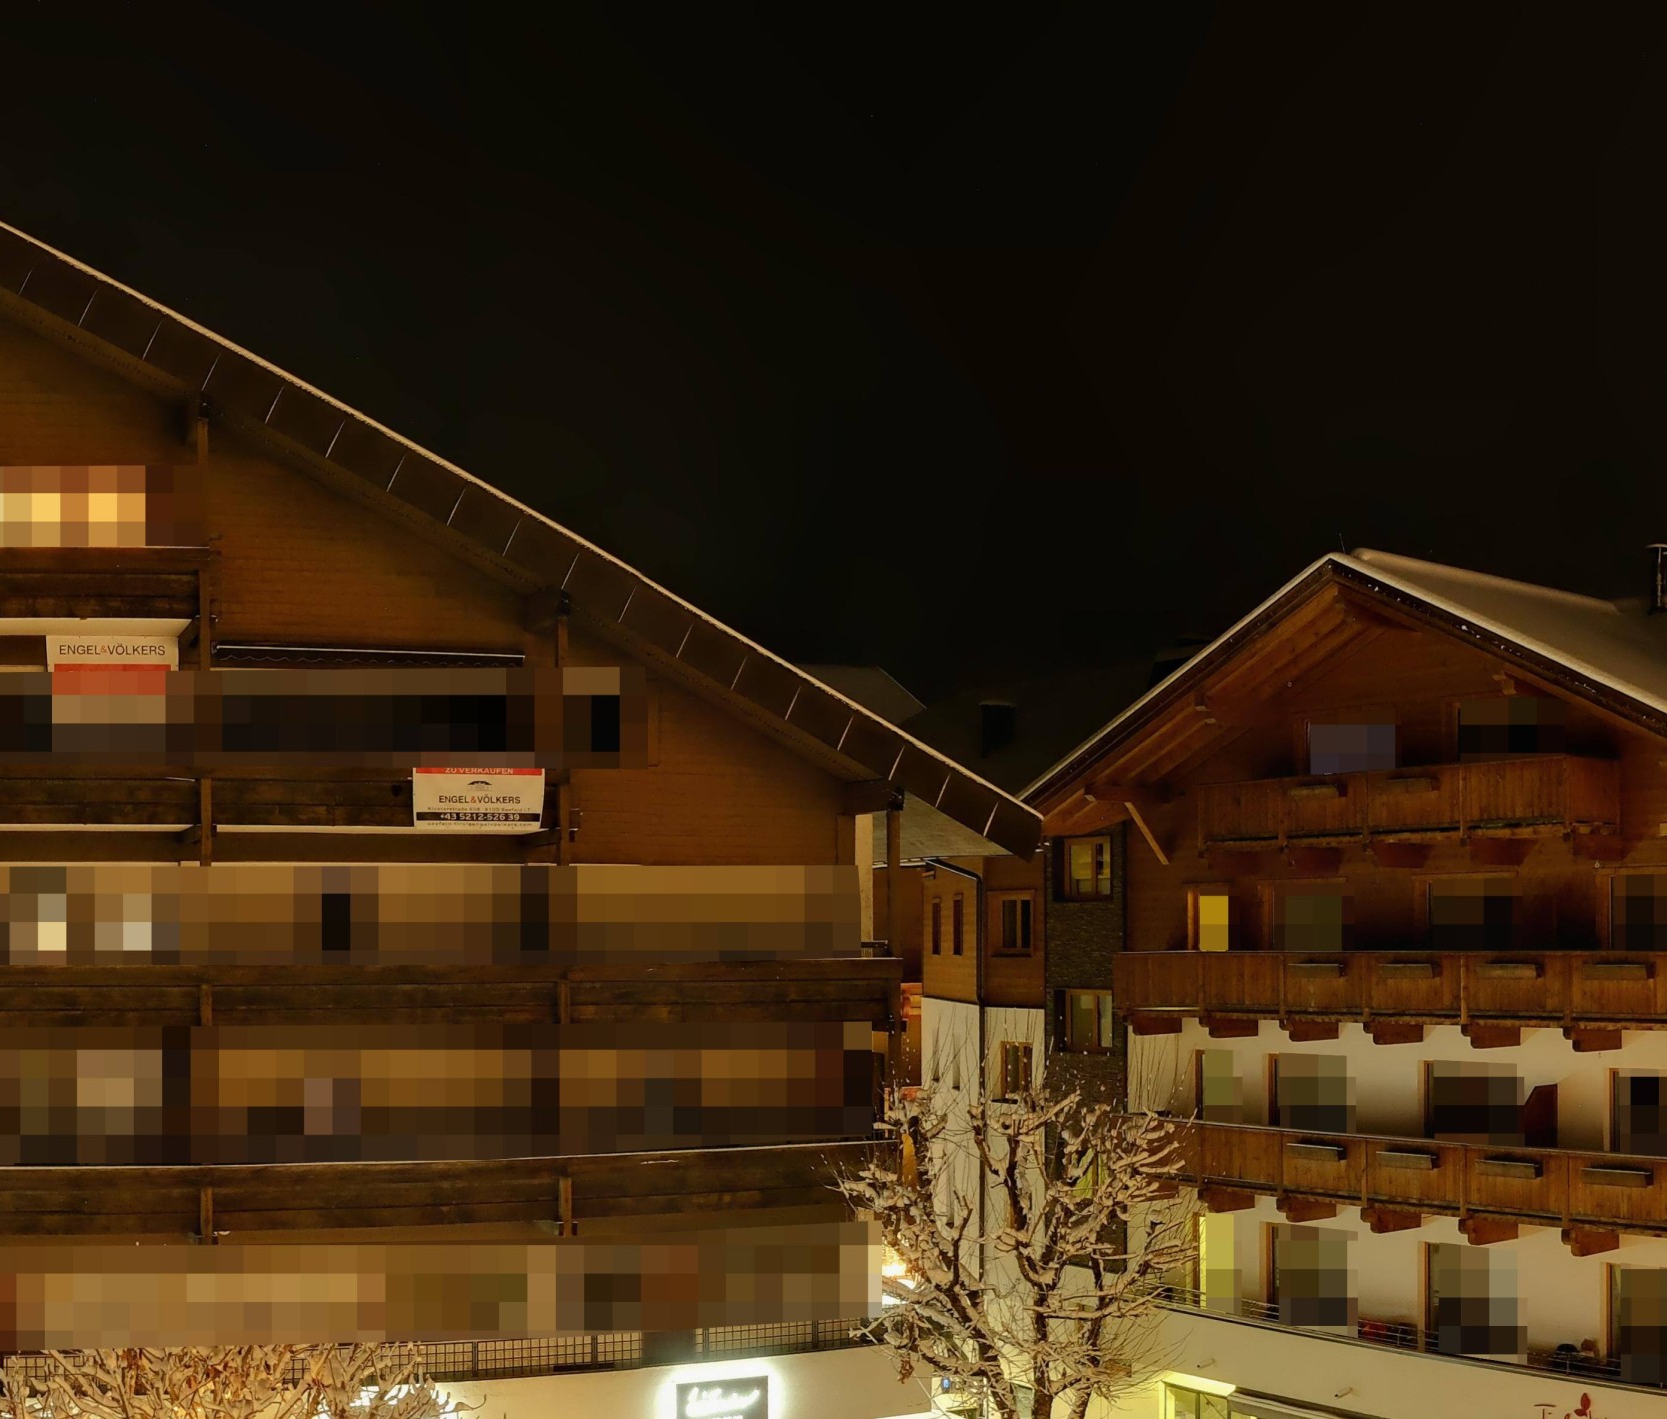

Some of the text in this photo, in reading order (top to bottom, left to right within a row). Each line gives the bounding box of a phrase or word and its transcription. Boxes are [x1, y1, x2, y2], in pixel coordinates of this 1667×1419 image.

[58, 642, 166, 656] ENGEL&VÖLKERS
[459, 813, 505, 821] 5212-526
[508, 813, 520, 821] 39
